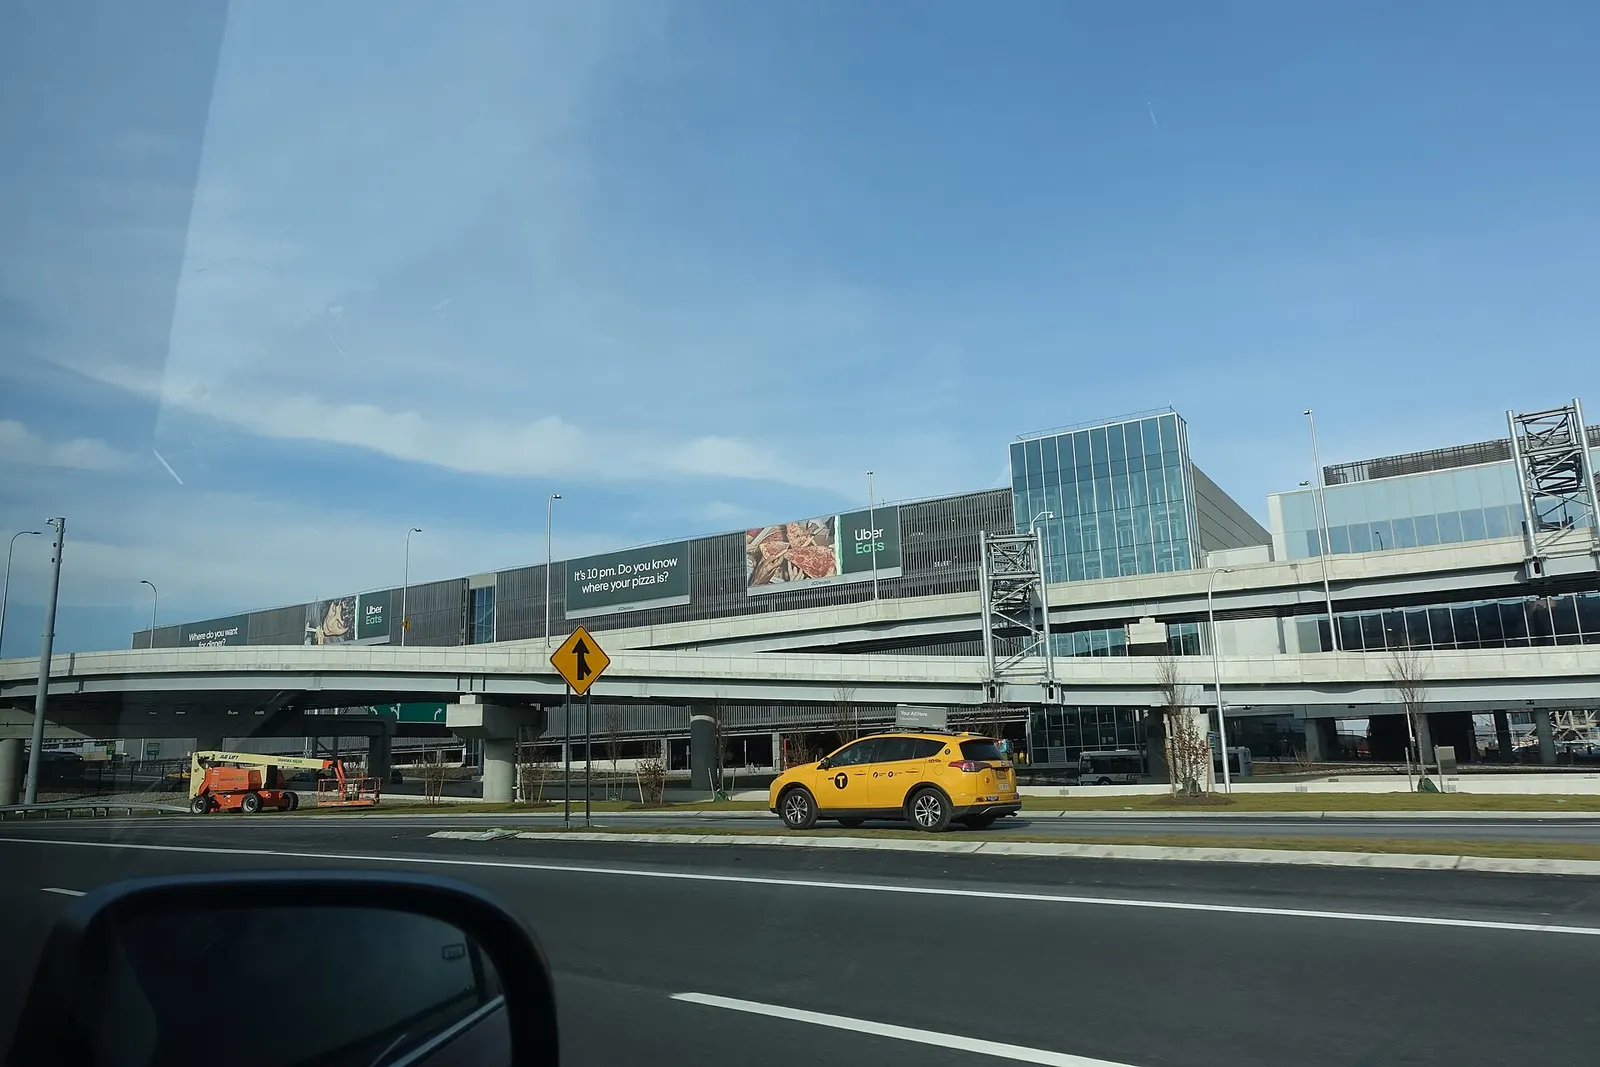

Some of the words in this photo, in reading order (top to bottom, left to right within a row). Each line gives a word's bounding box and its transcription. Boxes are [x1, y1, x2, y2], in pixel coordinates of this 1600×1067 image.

[855, 528, 884, 541] Uber
[855, 542, 885, 554] Eats
[574, 570, 586, 581] It's
[587, 568, 598, 579] 10
[599, 567, 617, 580] pm.
[618, 564, 631, 575] Do
[633, 562, 651, 575] you
[652, 558, 678, 570] know
[582, 582, 609, 593] where
[610, 579, 630, 592] your
[632, 575, 655, 589] pizza
[657, 571, 669, 583] is?
[366, 606, 383, 615] Uber
[366, 615, 382, 625] Eats
[188, 632, 205, 642] Where
[206, 630, 214, 639] do
[214, 630, 225, 640] you
[225, 627, 238, 637] want
[207, 638, 227, 648] dinner?
[837, 775, 845, 788] T
